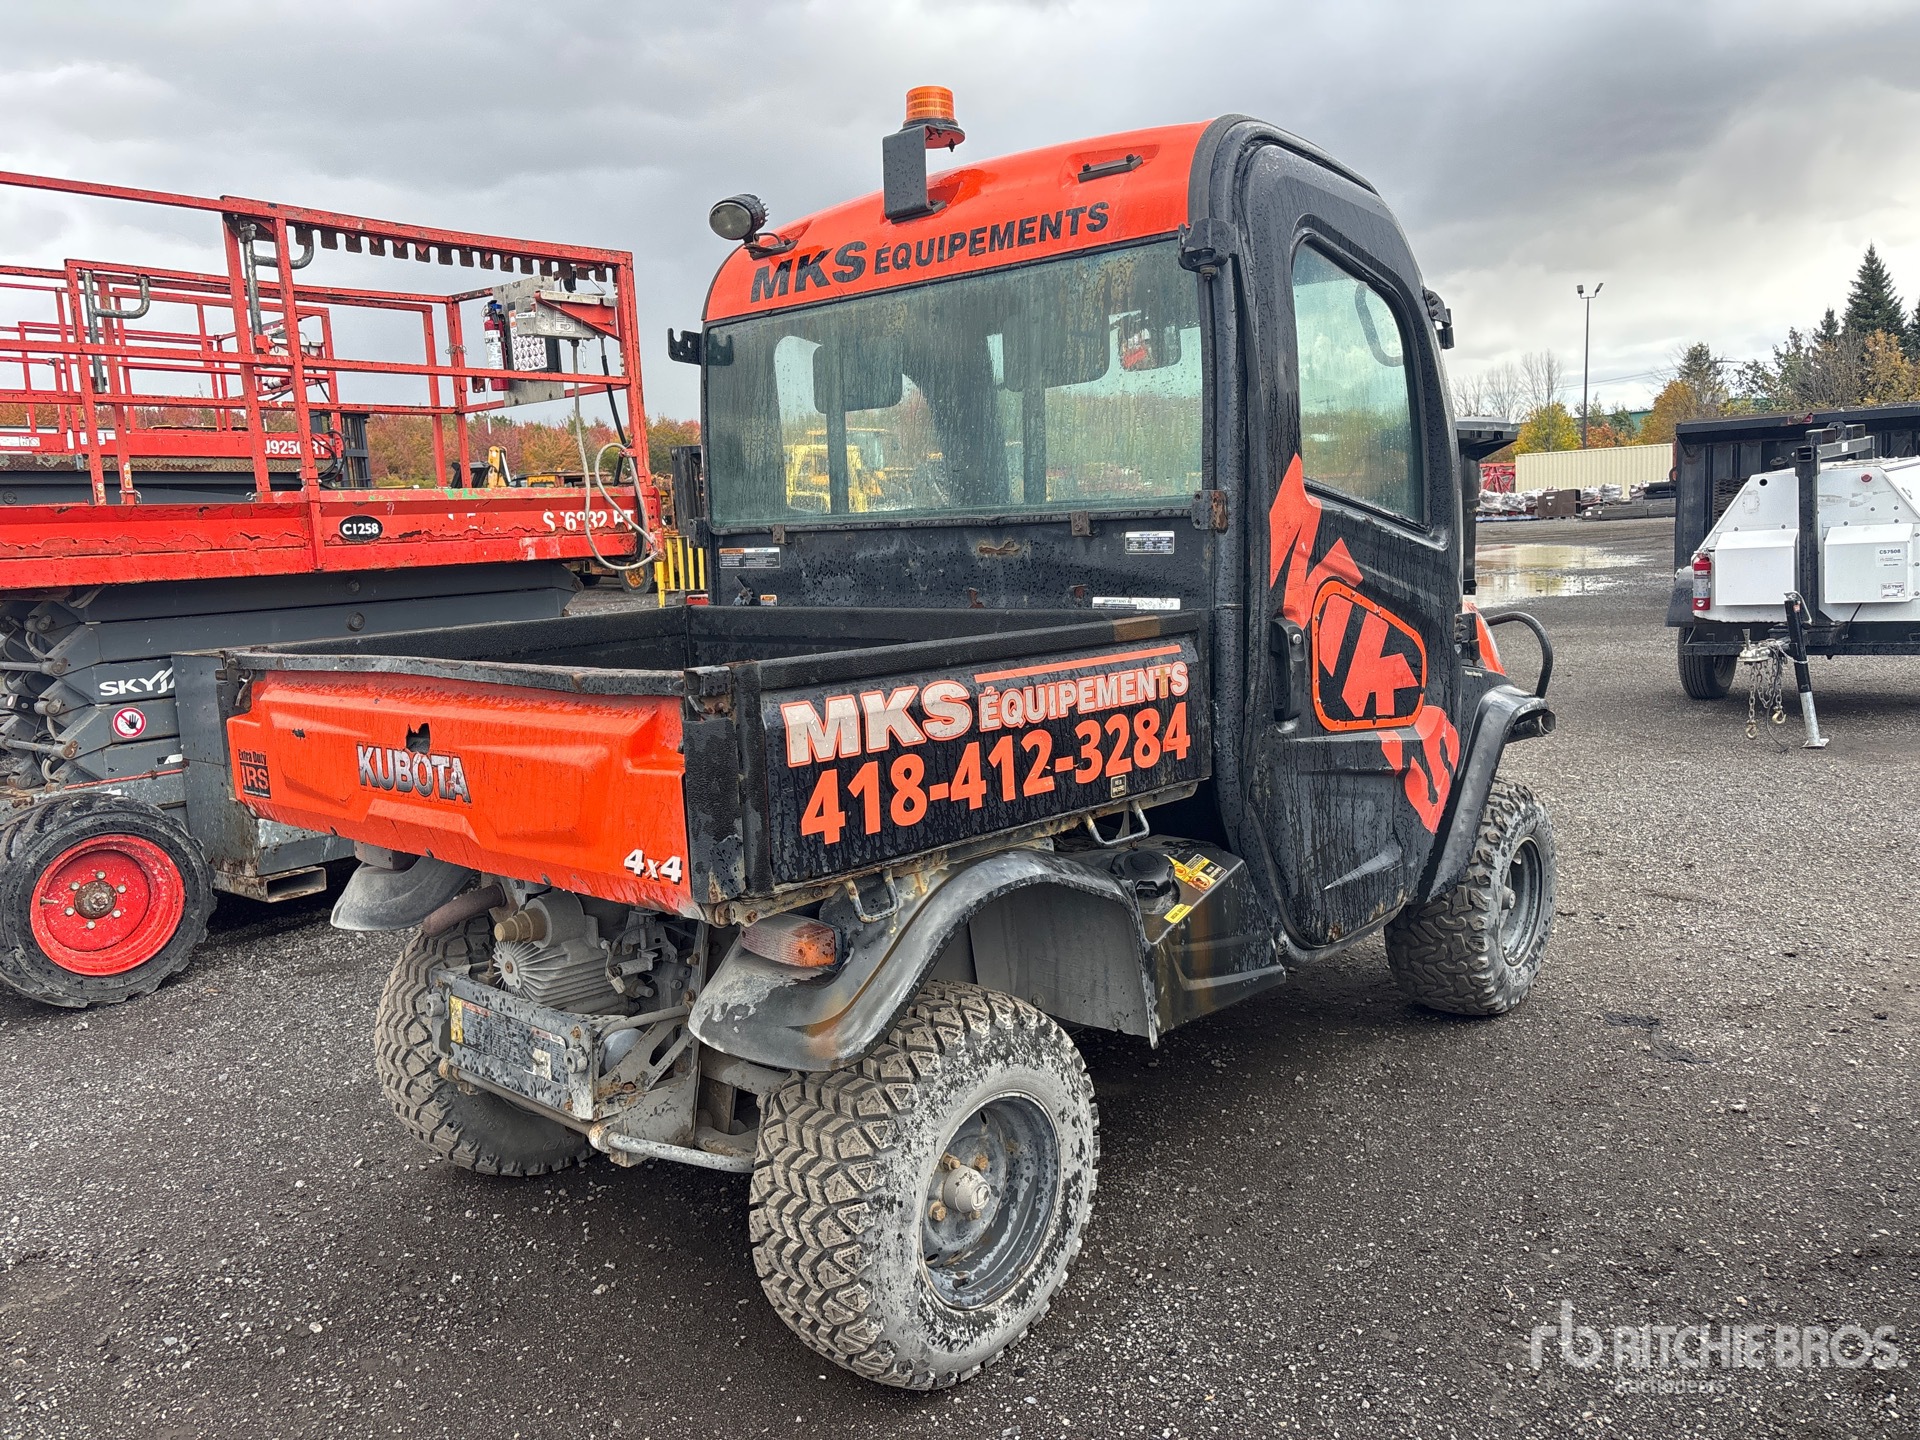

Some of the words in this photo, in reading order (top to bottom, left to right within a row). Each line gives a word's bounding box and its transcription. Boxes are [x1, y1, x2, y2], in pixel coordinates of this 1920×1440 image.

[750, 240, 868, 303] MKS
[874, 201, 1110, 275] ÉQUIPEMENTS
[342, 522, 380, 535] C1258
[1269, 452, 1461, 834] MKS
[780, 680, 974, 768] MKS
[978, 660, 1190, 732] ÉQUIPEMENTS
[238, 749, 253, 763] Extra
[252, 750, 267, 765] Duty
[241, 766, 269, 791] IRS
[356, 744, 473, 804] KUBOTA
[800, 702, 1191, 845] 418-412-3284
[623, 848, 683, 886] 4x4
